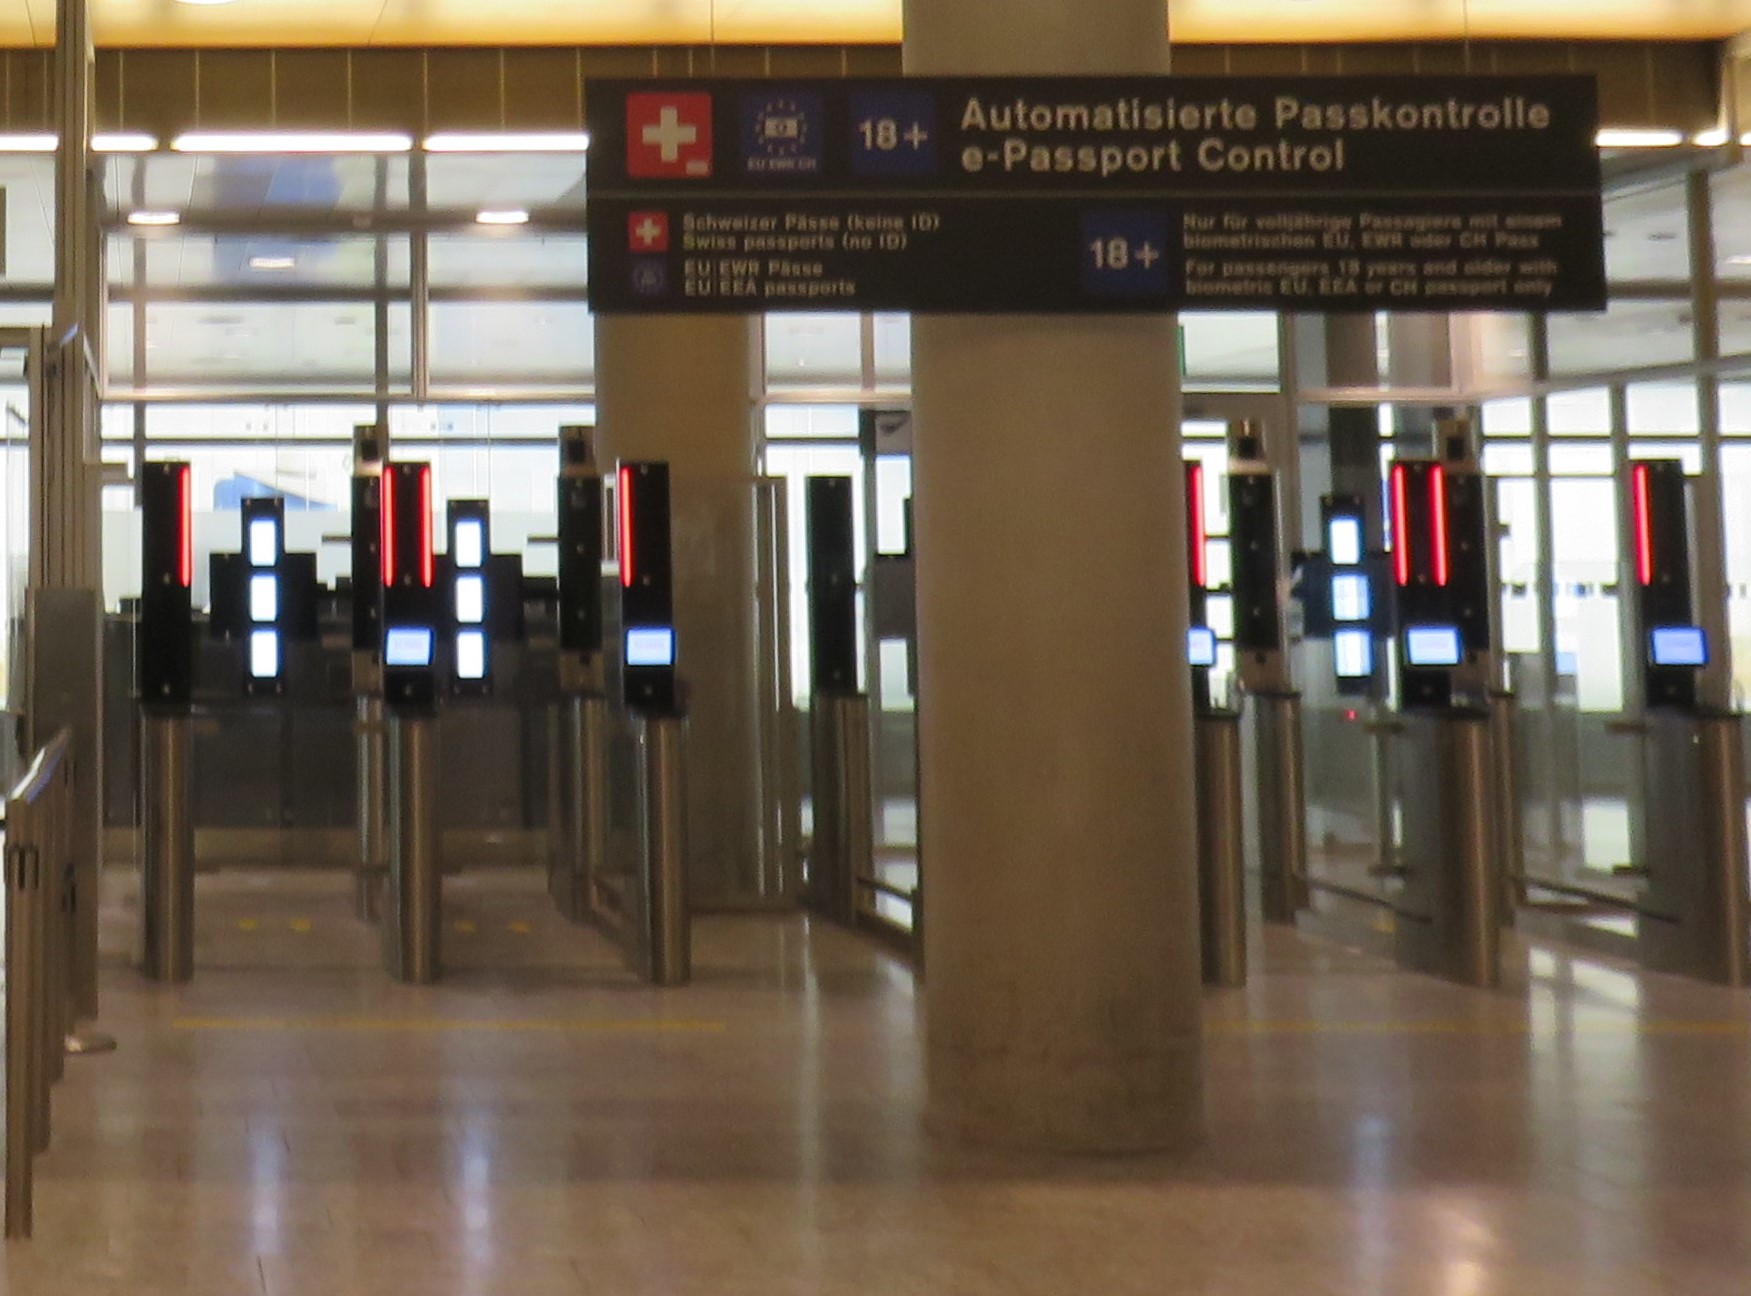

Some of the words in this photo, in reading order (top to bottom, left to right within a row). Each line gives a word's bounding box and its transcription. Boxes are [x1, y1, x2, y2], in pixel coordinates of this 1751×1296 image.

[961, 98, 1256, 130] Automatisierte
[1274, 97, 1551, 130] Passkontrolle
[859, 118, 928, 150] 18+
[961, 139, 1182, 175] e-Passport
[1198, 138, 1345, 171] Control
[683, 213, 777, 231] Schweizer
[785, 213, 840, 231] Pässe
[847, 213, 904, 231] (keine
[912, 213, 940, 231] ID)
[683, 233, 737, 249] Swiss
[744, 233, 835, 252] passports
[842, 233, 872, 250] (no
[880, 233, 907, 250] ID)
[1089, 238, 1159, 270] 18+
[765, 279, 856, 298] passports
